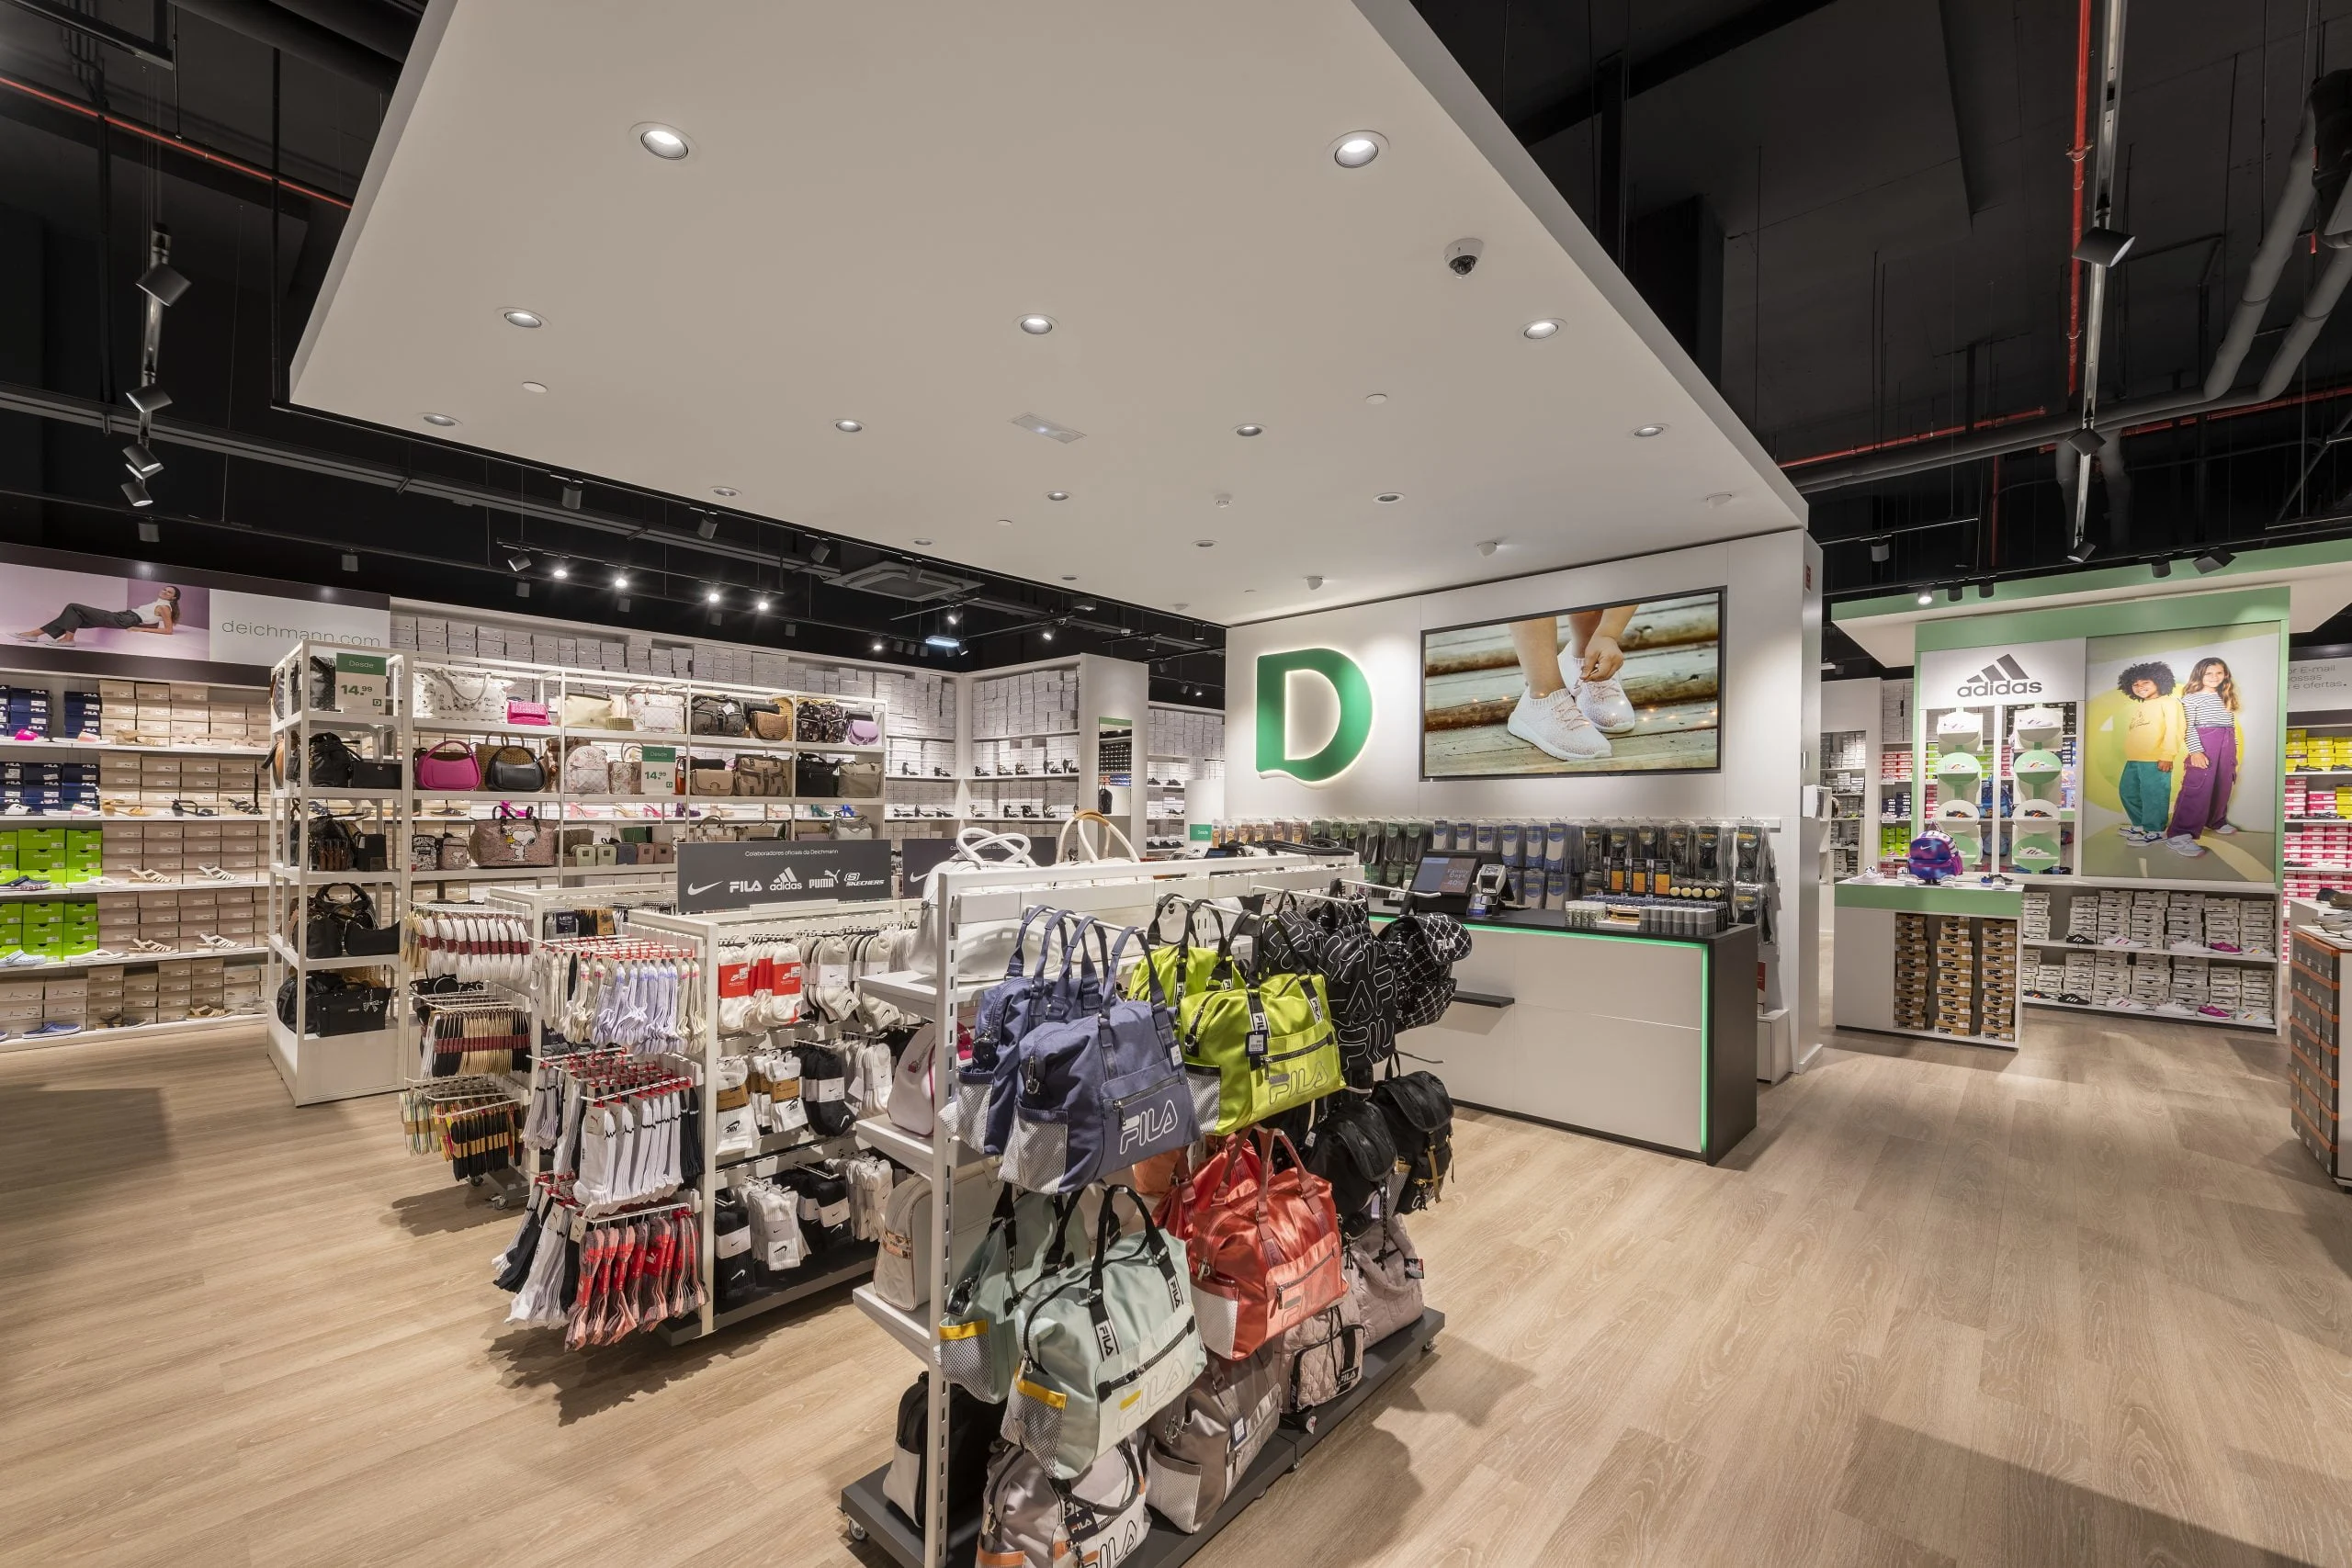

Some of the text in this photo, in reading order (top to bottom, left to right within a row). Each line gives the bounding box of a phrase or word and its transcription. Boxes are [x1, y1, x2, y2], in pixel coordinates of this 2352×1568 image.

[348, 660, 374, 669] Desde
[2300, 665, 2335, 674] E-mail
[341, 684, 373, 696] 14.99
[1957, 680, 2042, 697] adidas
[1256, 647, 1374, 783] D
[729, 880, 763, 894] FILA
[770, 881, 803, 891] adidas
[808, 877, 834, 889] PUMA
[845, 879, 885, 887] SKECHERS
[1311, 998, 1321, 1023] FILA
[1255, 1014, 1265, 1031] FIL
[1268, 1060, 1329, 1105] FILA
[1120, 1100, 1178, 1155] FILA
[1169, 1280, 1182, 1308] FILA
[1100, 1325, 1114, 1356] FILA
[1339, 1372, 1356, 1384] FILA
[1071, 1518, 1093, 1534] FILA
